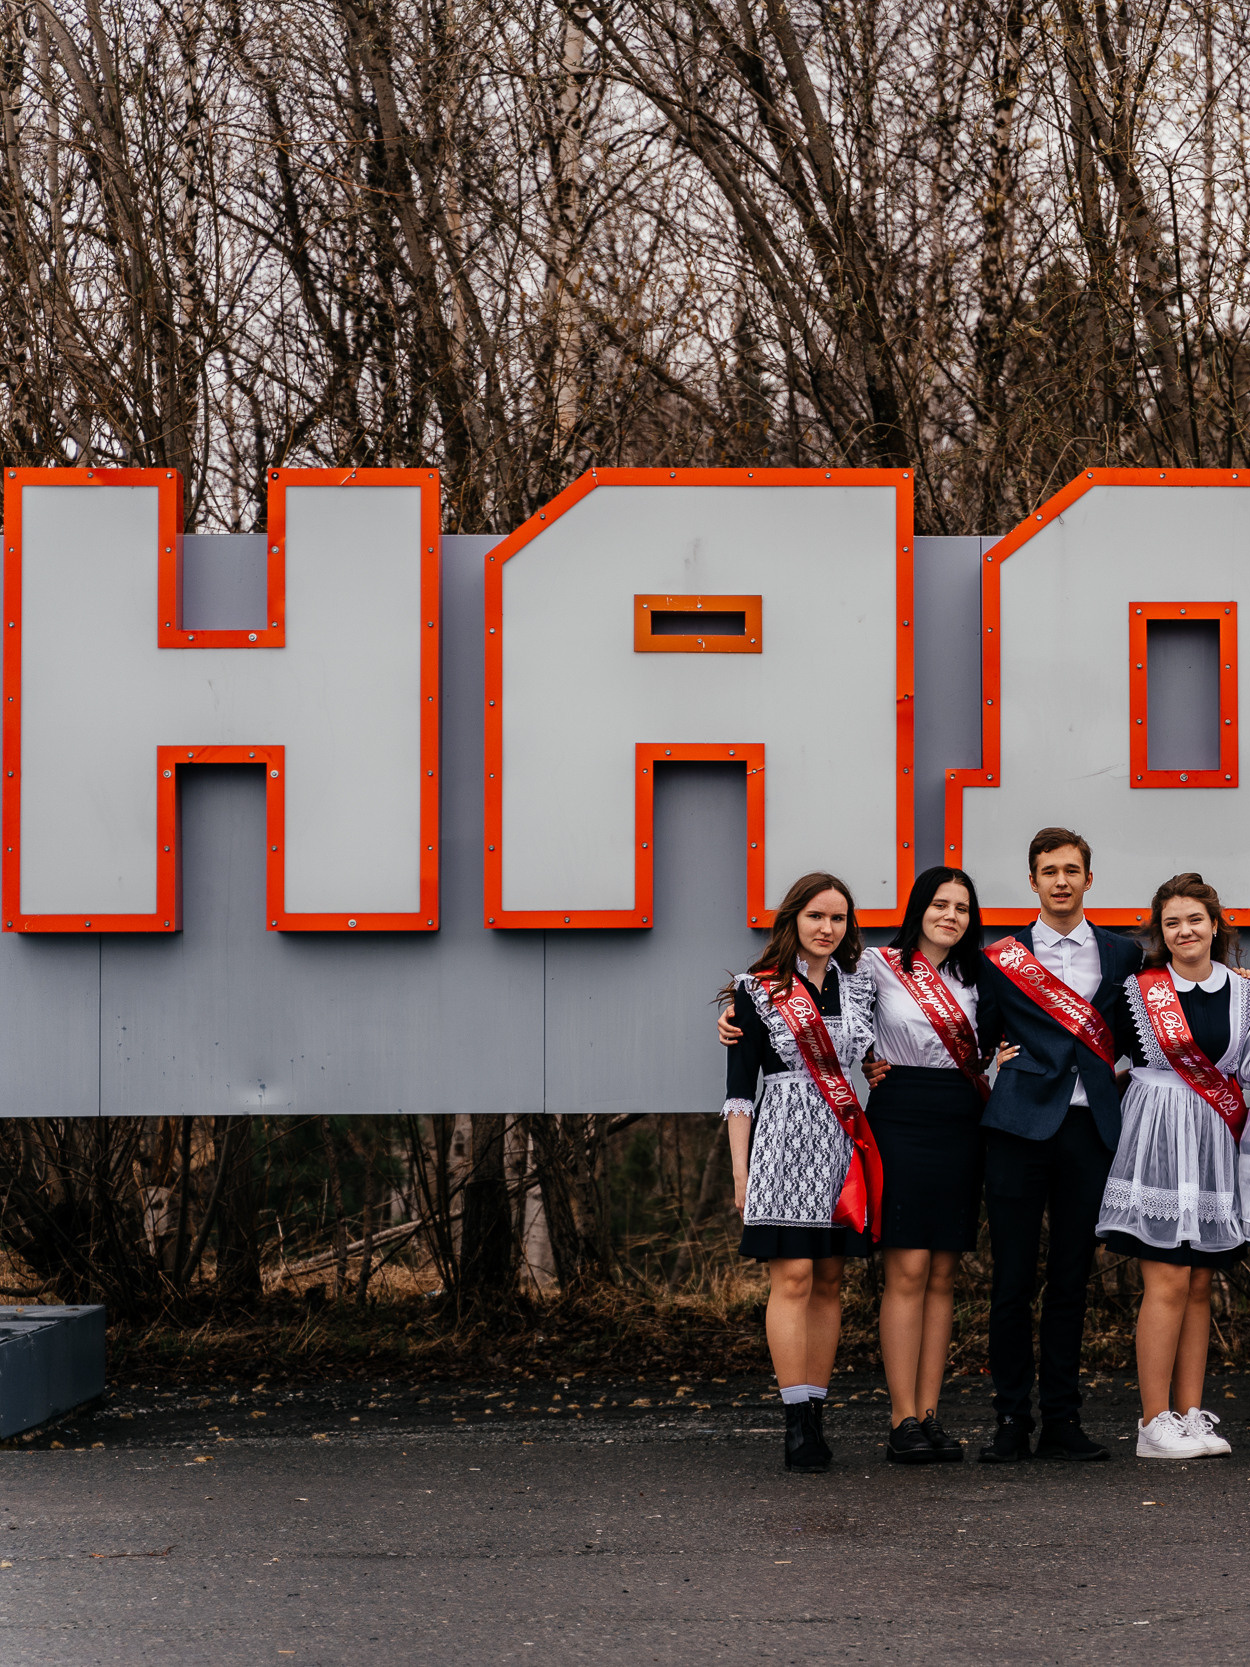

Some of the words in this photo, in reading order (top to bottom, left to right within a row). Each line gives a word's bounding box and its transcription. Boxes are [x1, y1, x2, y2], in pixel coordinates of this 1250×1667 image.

[787, 996, 836, 1088] Выпускница
[1019, 964, 1096, 1036] Выпускник
[1160, 1010, 1211, 1088] Выпускница
[1205, 1081, 1239, 1116] 2022
